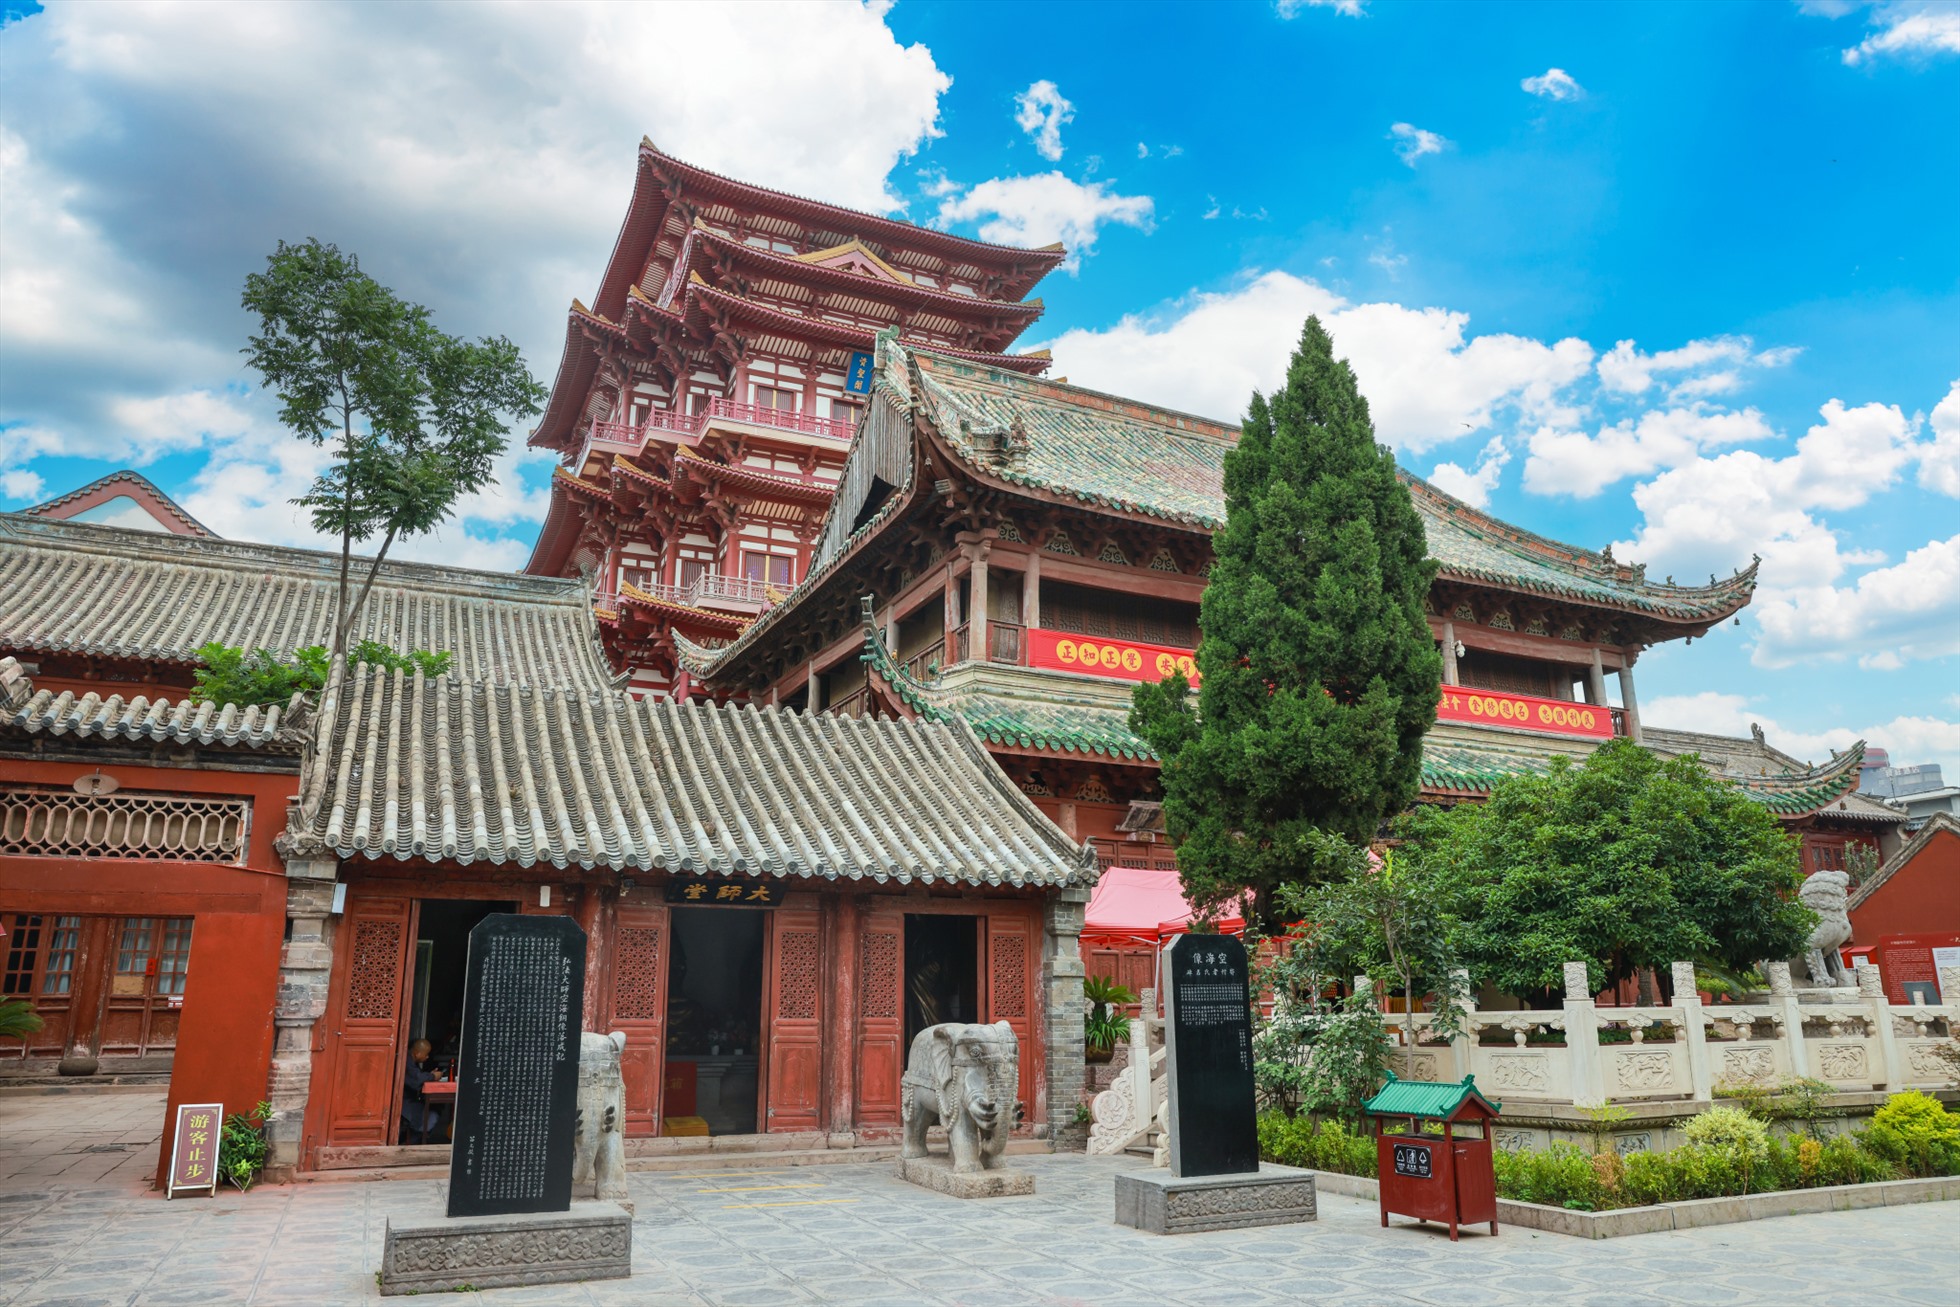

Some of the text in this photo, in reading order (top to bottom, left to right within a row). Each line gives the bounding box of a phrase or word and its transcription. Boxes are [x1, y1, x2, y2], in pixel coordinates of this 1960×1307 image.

[1059, 643, 1140, 670] 正知正覺
[1158, 656, 1196, 677] 安身
[1436, 693, 1461, 712] 法會
[184, 1114, 210, 1180] 游客止步
